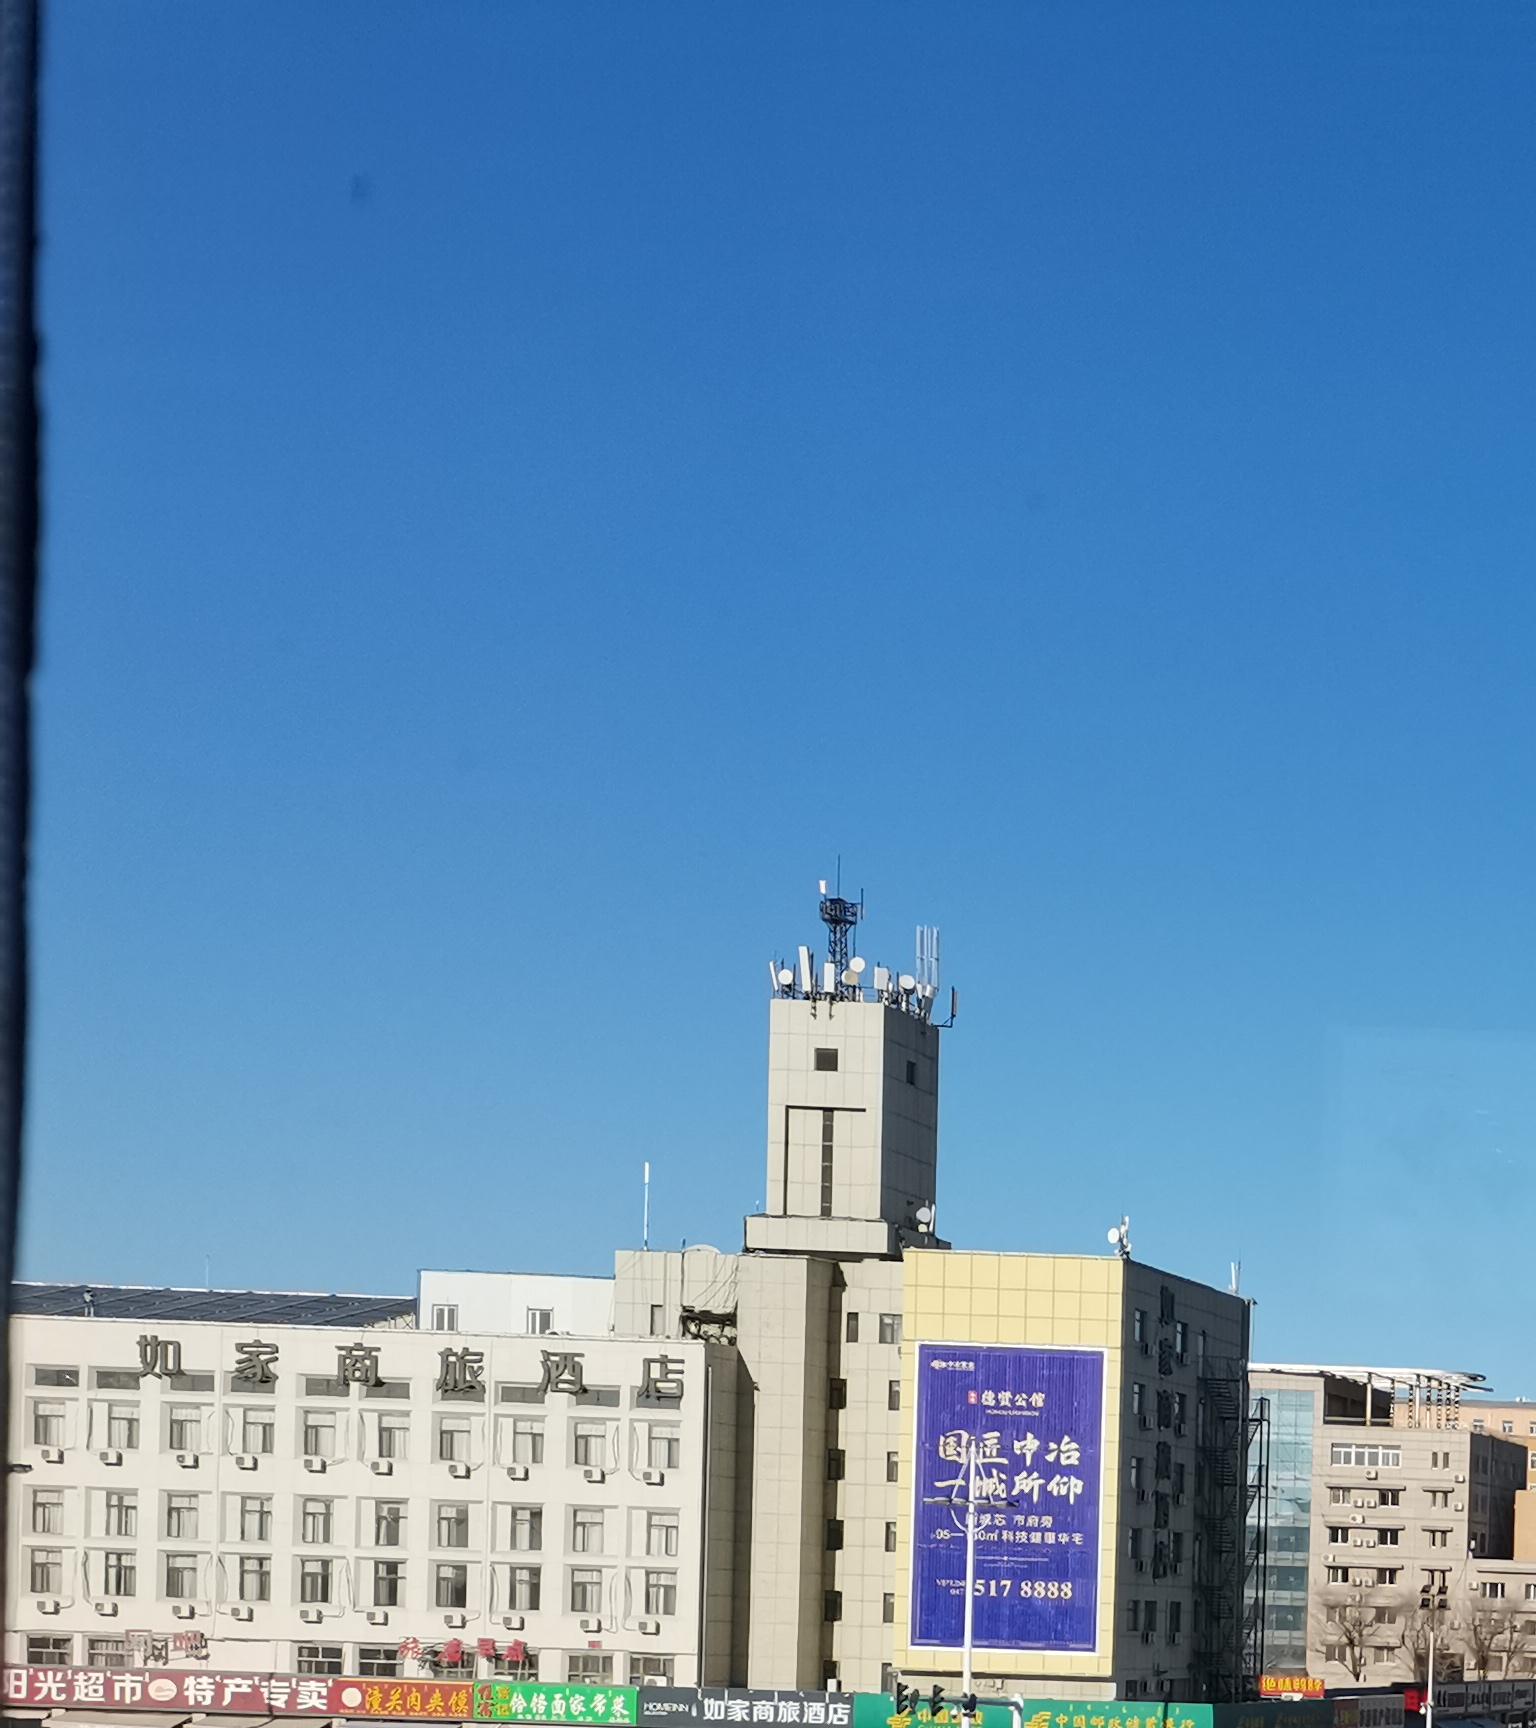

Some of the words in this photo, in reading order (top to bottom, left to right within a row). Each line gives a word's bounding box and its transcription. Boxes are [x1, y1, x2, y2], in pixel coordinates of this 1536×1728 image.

[136, 1333, 686, 1399] 如家商旅酒店
[1020, 1581, 1073, 1600] 8888
[184, 1676, 329, 1711] 特产专卖
[365, 1687, 469, 1713] 潼关肉夹馍
[703, 1698, 852, 1726] 如家商旅酒店
